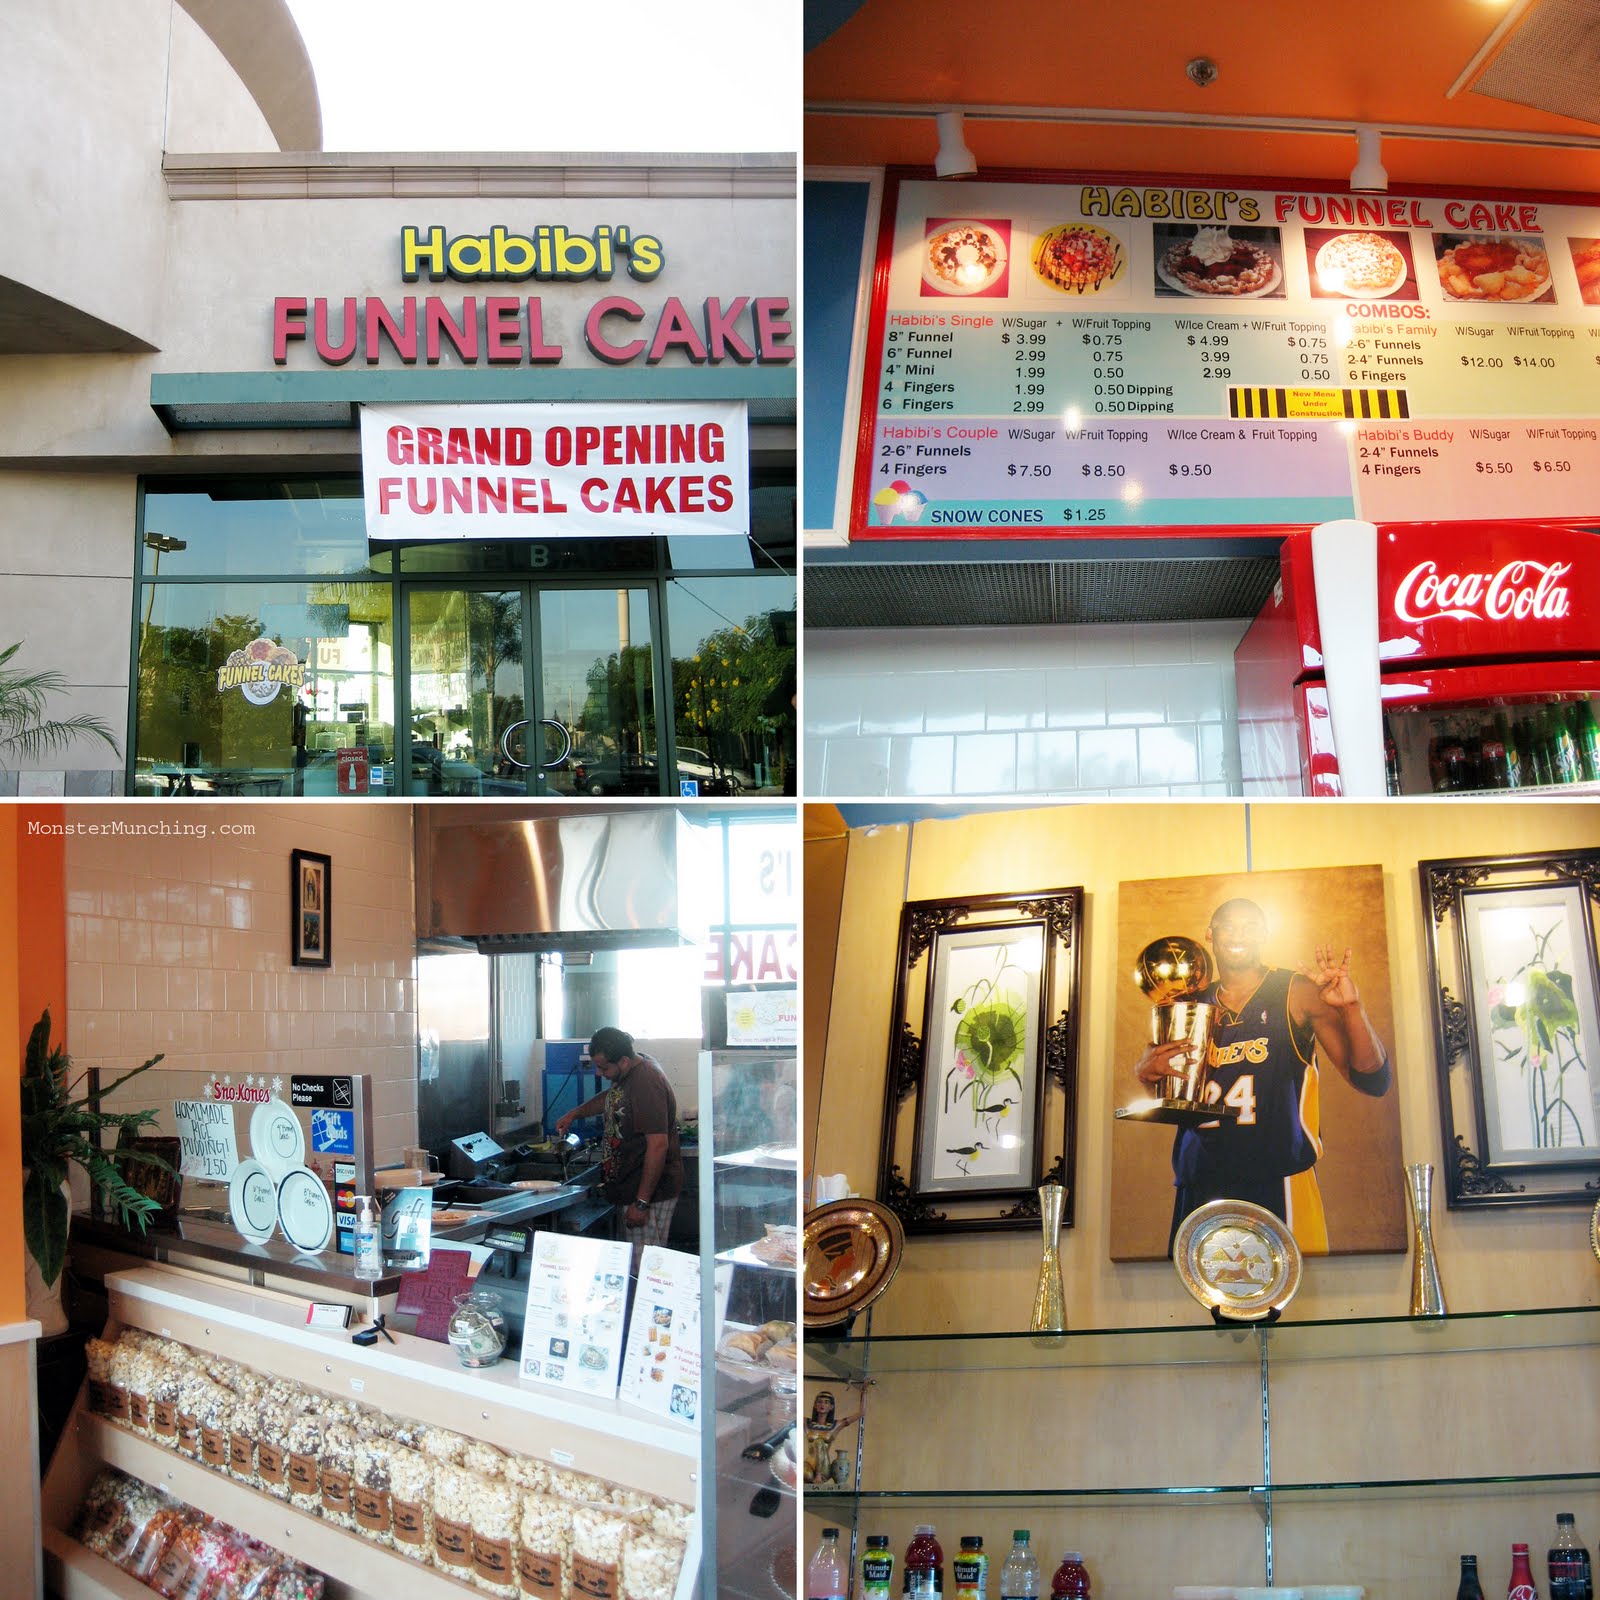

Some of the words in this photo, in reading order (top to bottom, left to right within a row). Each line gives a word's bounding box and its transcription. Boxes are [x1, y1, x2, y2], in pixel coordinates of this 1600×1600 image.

[1275, 195, 1433, 228] FUNNEL
[1445, 201, 1543, 233] CAKE
[402, 225, 664, 281] Habibi's
[1345, 303, 1431, 320] COMBOS:
[890, 314, 947, 327] Habibi's
[950, 315, 994, 330] Single
[1001, 318, 1047, 331] W/Sugar
[1072, 319, 1109, 330] W/Fruit
[1111, 319, 1151, 332] Topping
[1174, 320, 1204, 331] W/Ice
[1206, 320, 1239, 331] Cream
[1251, 320, 1287, 332] W/Fruit
[1288, 321, 1327, 335] Topping
[273, 296, 563, 366] FUNNEL
[583, 295, 796, 366] CAKE
[889, 331, 904, 343] 8"
[908, 331, 954, 343] Funnel
[1350, 323, 1396, 335] abibi's
[1397, 323, 1438, 338] Family
[1455, 326, 1494, 339] W/Sugar
[1507, 326, 1540, 338] W/Fruit
[1541, 327, 1575, 340] Topping
[1374, 339, 1422, 351] Funnels
[887, 347, 903, 360] 6"
[906, 348, 953, 360] Funnel
[1015, 350, 1046, 362] 2.99
[1093, 350, 1123, 362] 0.75
[1200, 351, 1231, 363] 3.99
[1300, 353, 1329, 365] 0.75
[1347, 354, 1373, 365] 2-4"
[1376, 354, 1424, 367] Funnels
[1461, 355, 1503, 369] $12.00
[1513, 355, 1556, 369] $14.00
[886, 364, 901, 376] 4"
[905, 364, 935, 376] Mini
[1015, 366, 1046, 379] 1.99
[1093, 367, 1124, 379] 0.50
[1203, 367, 1232, 379] 2.99
[1301, 369, 1331, 381] 0.50
[1349, 369, 1358, 381] 6
[1361, 369, 1407, 384] Fingers
[884, 381, 894, 393] 4
[904, 381, 955, 396] Fingers
[1015, 384, 1046, 396] 1.99
[1094, 384, 1125, 396] 0.50
[1127, 383, 1174, 398] Dipping
[882, 398, 892, 410] 6
[902, 398, 954, 413] Fingers
[1013, 401, 1045, 413] 2.99
[1094, 401, 1126, 413] 0.50
[1127, 400, 1174, 415] Dipping
[883, 426, 942, 439] Habibi's
[946, 426, 999, 441] Couple
[1008, 429, 1056, 442] W/Sugar
[1065, 429, 1105, 441] W/Fruit
[1106, 429, 1149, 443] Topping
[1167, 429, 1198, 440] W/Ice
[1200, 429, 1236, 441] Cream
[1238, 429, 1246, 440] &
[1252, 429, 1276, 440] Fruit
[1277, 429, 1318, 443] Topping
[1358, 429, 1410, 441] Habibi's
[1413, 429, 1455, 444] Buddy
[1469, 428, 1511, 442] W/Sugar
[1526, 428, 1559, 440] W/Fruit
[1560, 428, 1597, 442] Topping
[386, 425, 532, 467] GRAND
[545, 422, 726, 466] OPENING
[881, 445, 912, 457] 2-6"
[916, 444, 972, 457] Funnels
[1359, 447, 1386, 459] 2-4"
[1389, 446, 1439, 459] Funnels
[880, 463, 890, 475] 4
[894, 463, 947, 477] Fingers
[1361, 463, 1370, 475] 4
[1373, 463, 1421, 477] Fingers
[378, 476, 567, 516] FUNNEL
[580, 474, 735, 514] CAKES
[931, 509, 984, 524] SNOW
[988, 509, 1044, 523] CONES
[530, 545, 549, 568] B
[1394, 560, 1573, 624] Coca-Cola
[219, 664, 265, 690] FUNNEL
[268, 663, 306, 688] CAKES
[292, 1083, 301, 1092] No
[301, 1083, 324, 1092] Checks
[292, 1093, 313, 1102] Please
[174, 1101, 229, 1125] HOMEMADE
[191, 1119, 212, 1140] RICE
[182, 1136, 230, 1159] PUDDING!
[203, 1157, 227, 1176] $1.50
[339, 1216, 356, 1226] VISA
[865, 1563, 890, 1572] Minute
[869, 1571, 887, 1579] Maid
